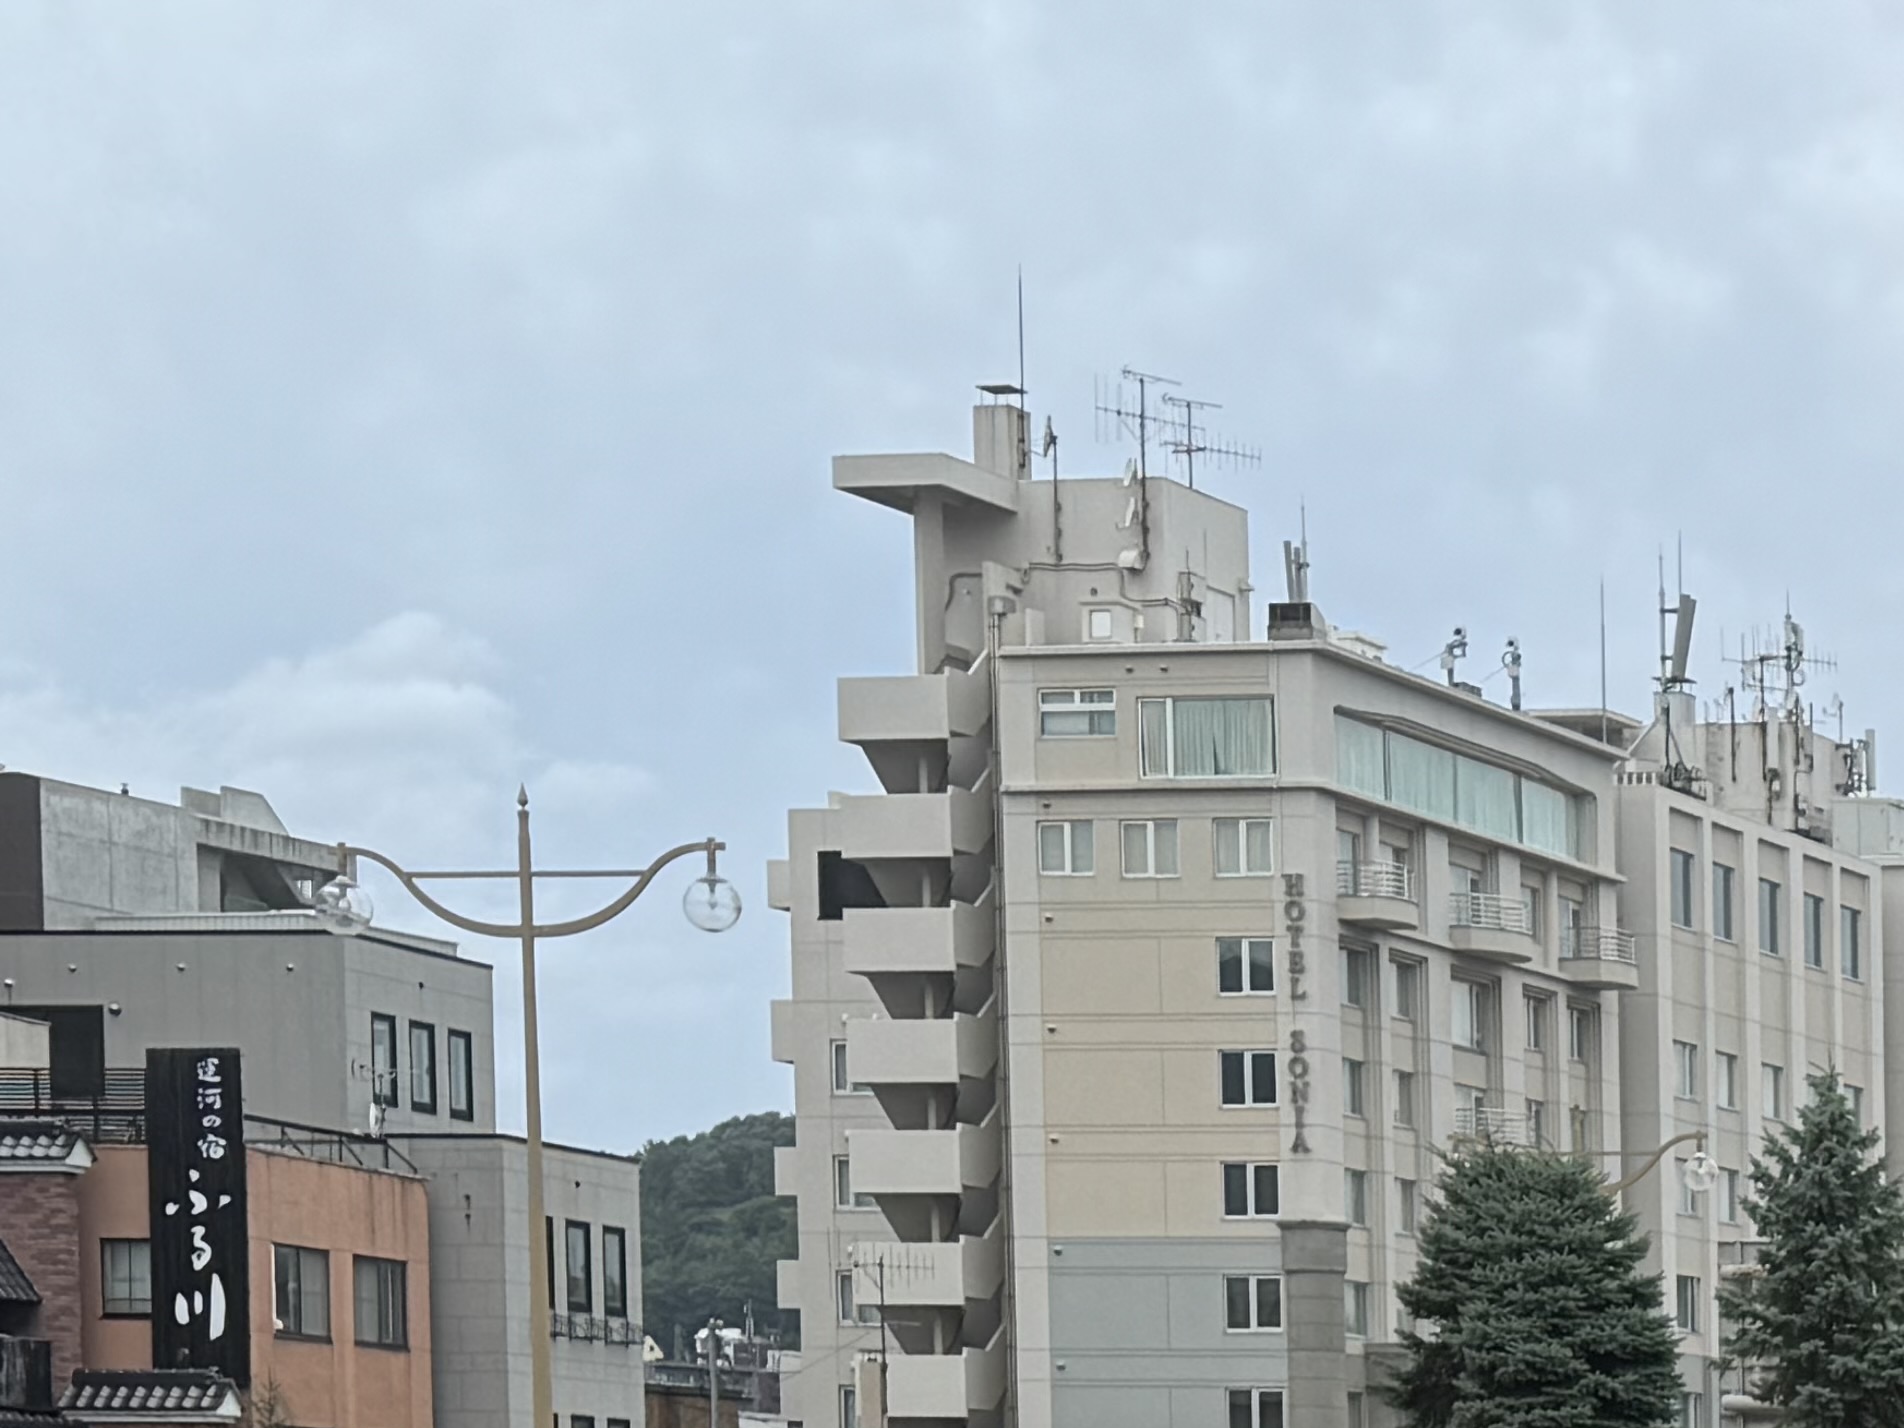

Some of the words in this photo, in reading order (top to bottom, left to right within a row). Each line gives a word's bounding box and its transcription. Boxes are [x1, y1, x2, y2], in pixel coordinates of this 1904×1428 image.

[1281, 873, 1307, 1001] HOTEL
[197, 1057, 227, 1160] 運河の宿
[1287, 1029, 1312, 1154] SONIA
[165, 1168, 232, 1341] ふる川
